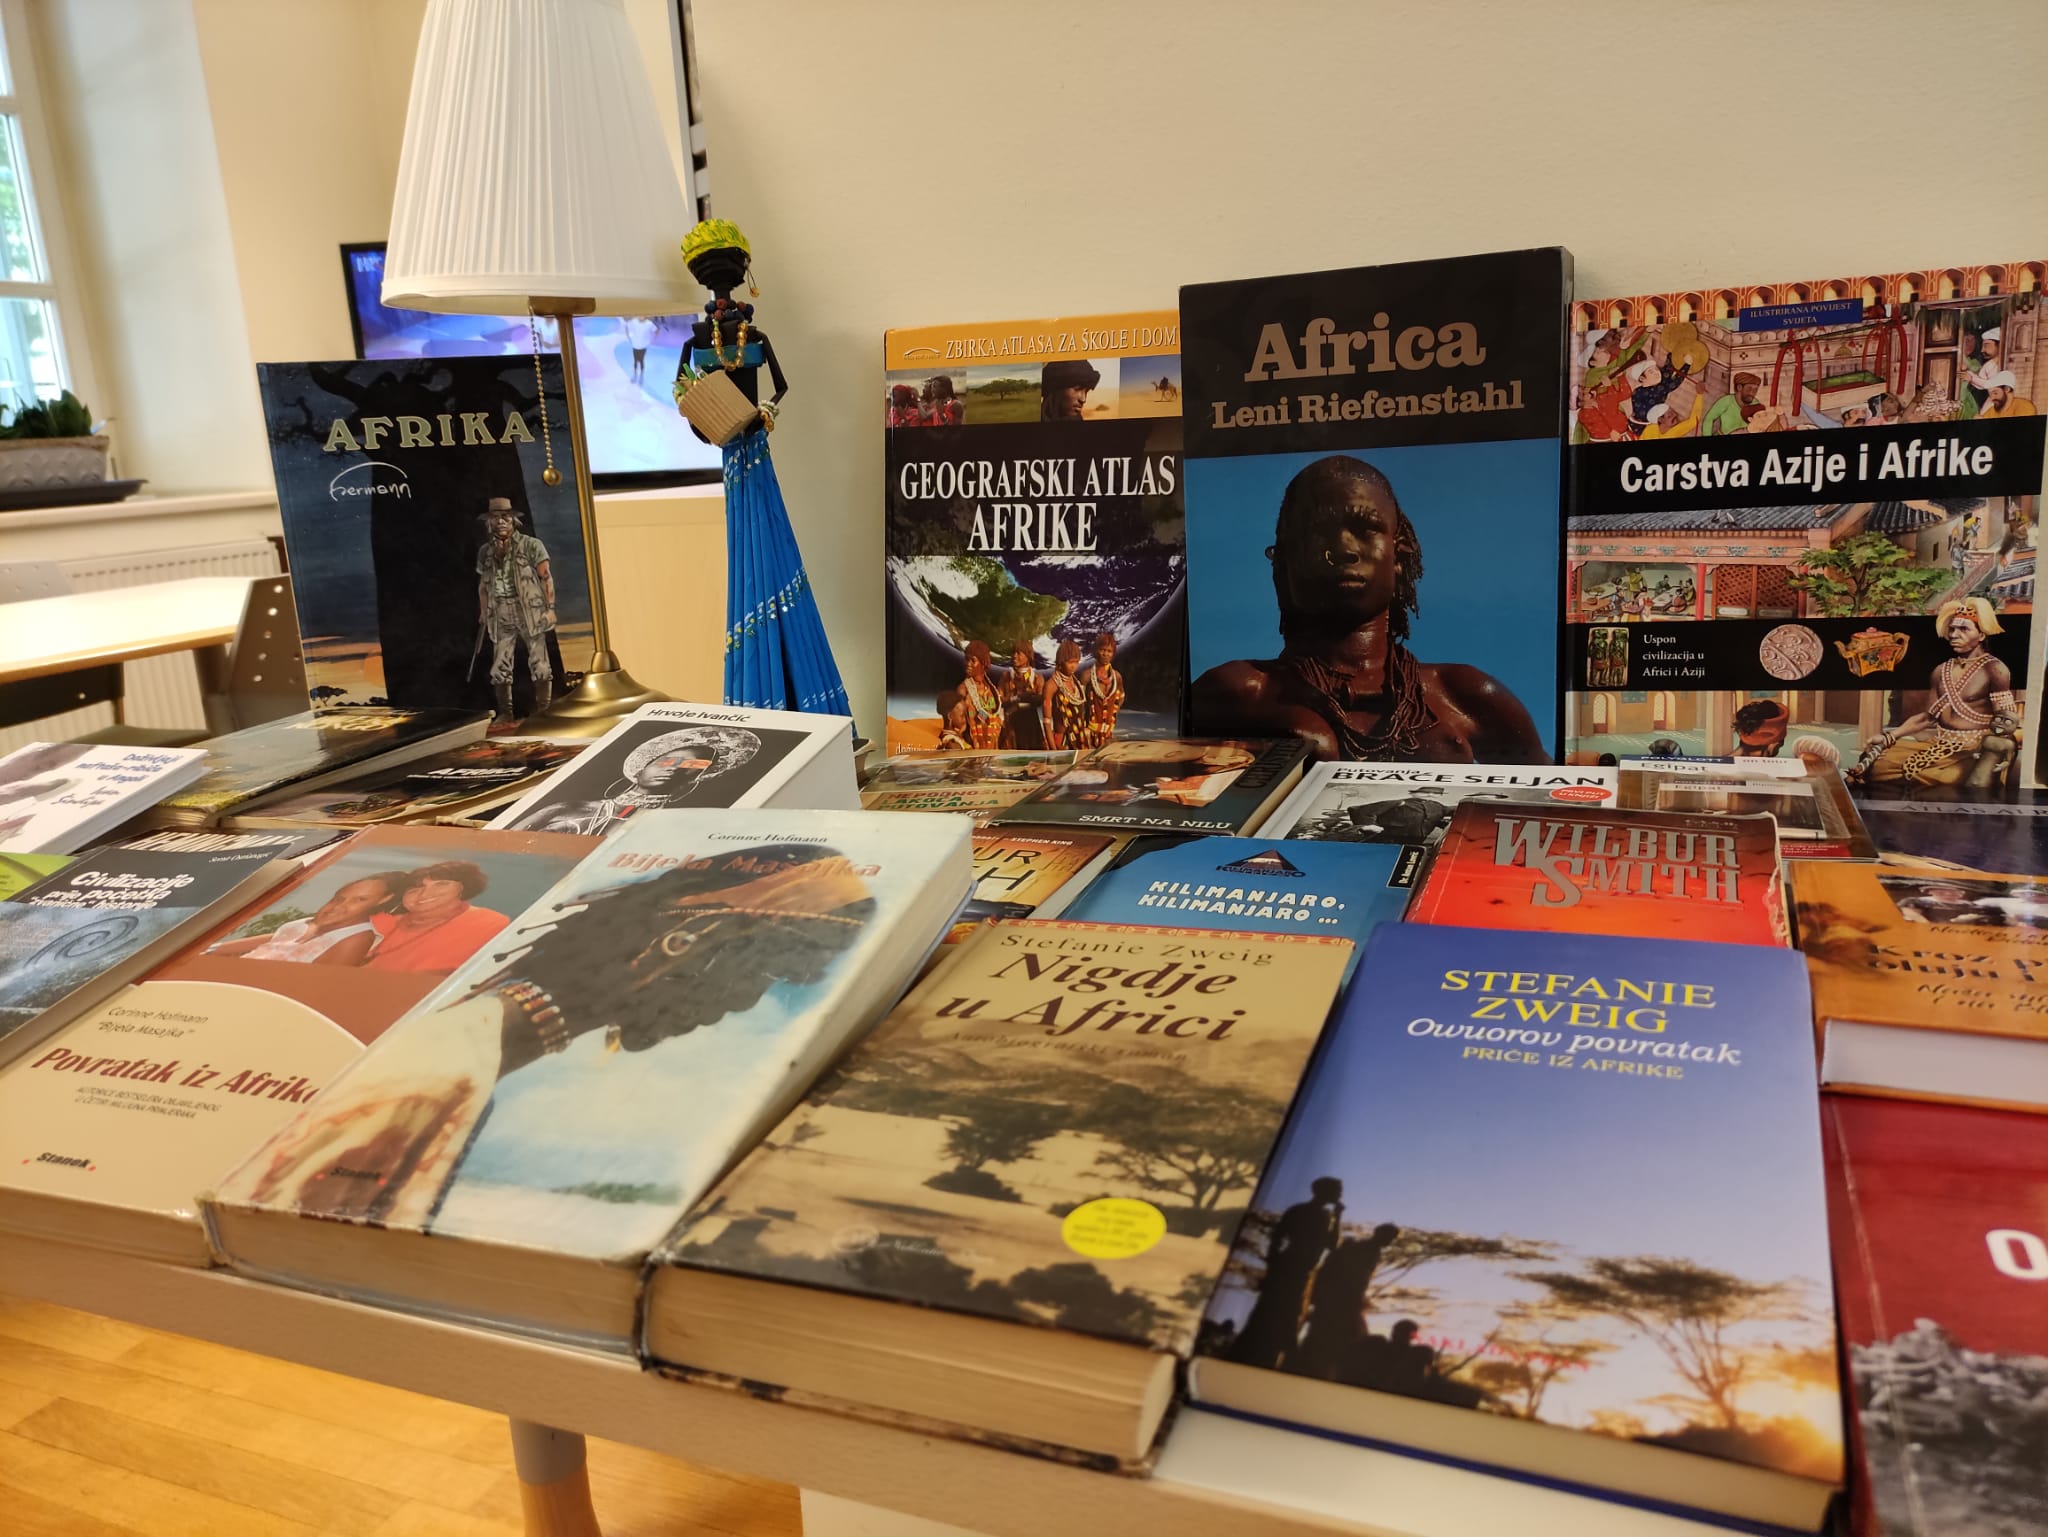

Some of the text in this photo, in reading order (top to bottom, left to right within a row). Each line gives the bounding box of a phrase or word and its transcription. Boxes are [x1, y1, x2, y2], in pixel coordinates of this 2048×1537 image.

[1750, 302, 1852, 319] ILUSTRIRANA POVIJEST
[1783, 315, 1817, 326] SVIJETA
[946, 326, 1177, 359] ZBIRKA ATLASA ZA ŠKOLE I DOM
[1244, 312, 1486, 382] Africa
[1212, 380, 1525, 430] Leni Riefenstahl
[323, 411, 535, 452] AFRIKA
[900, 455, 1176, 500] GEOGRAFSKI ATLAS
[1620, 438, 1994, 493] Carstva Azije i Afrike
[967, 502, 1098, 551] AFRIKE
[1643, 634, 1676, 648] Uspon
[1642, 650, 1705, 663] civilizacija u
[1642, 666, 1705, 679] Africi i Aziji
[648, 708, 751, 723] Hrvoje Ivančić
[1331, 770, 1605, 787] BRAĆE SELJAN
[1641, 762, 1708, 772] Egipat
[1078, 814, 1232, 830] SMRT NA NILU
[707, 832, 829, 844] Corinne Hofmann
[1010, 837, 1049, 845] STEPHEN
[1494, 818, 1741, 869] WILBUR
[608, 852, 882, 878] Bijela Masajka
[71, 872, 195, 894] Civilizacije
[81, 887, 173, 903] početka
[1149, 881, 1346, 910] KILIMANJARO,
[1532, 855, 1744, 908] SMITH
[1138, 894, 1311, 922] KILIMANJARO
[1001, 934, 1275, 966] Stefanie Zweig
[990, 952, 1238, 999] Nigdje
[1441, 968, 1717, 1008] STEFANIE
[108, 1007, 155, 1018] Corinne
[936, 995, 1247, 1041] u Africi
[1471, 996, 1669, 1034] ZWEIG
[1407, 1017, 1743, 1065] Owuorov povratak
[31, 1048, 182, 1087] Povratak
[180, 1063, 221, 1089] iz
[1463, 1045, 1685, 1080] PRIČE IZ AFRIKE
[37, 1152, 92, 1169] Stanek
